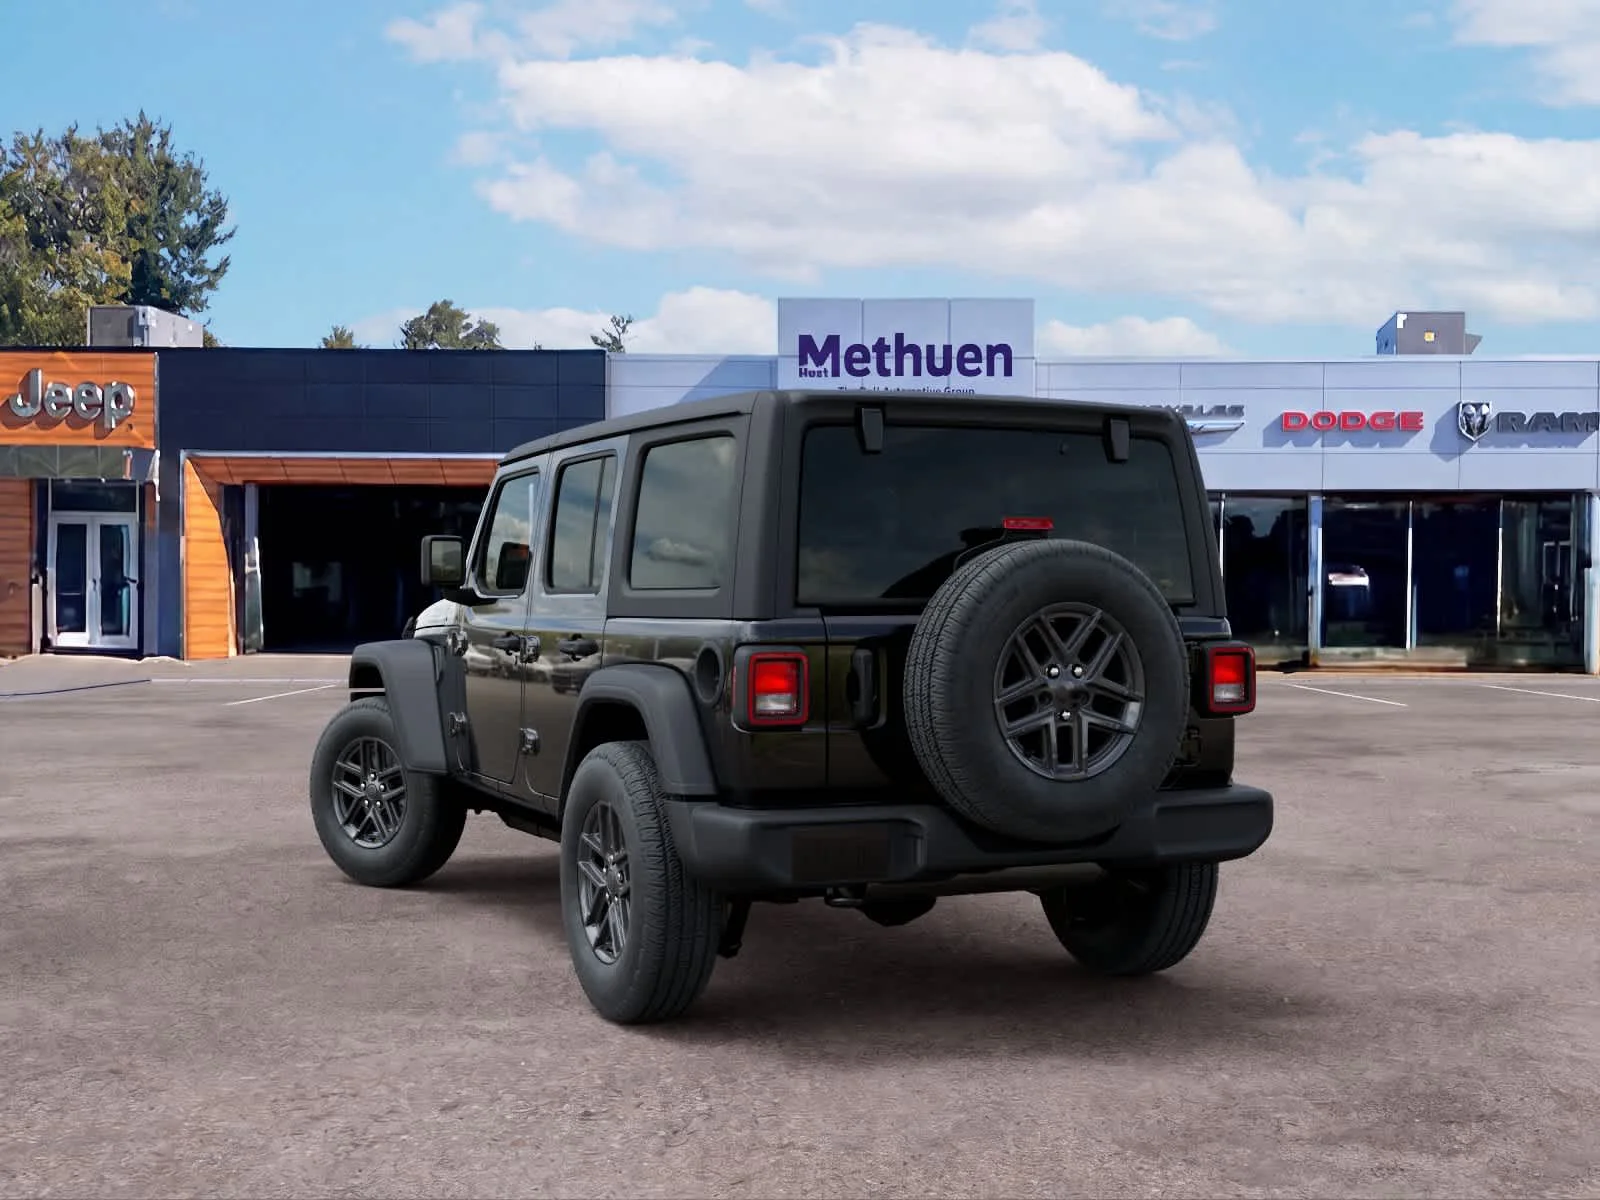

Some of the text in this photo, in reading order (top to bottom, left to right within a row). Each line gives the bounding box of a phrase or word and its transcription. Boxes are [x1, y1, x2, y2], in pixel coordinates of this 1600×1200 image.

[798, 332, 1014, 378] Methuen
[9, 368, 136, 429] Jeep
[1281, 411, 1424, 432] DODGE
[1496, 411, 1600, 433] RAM
